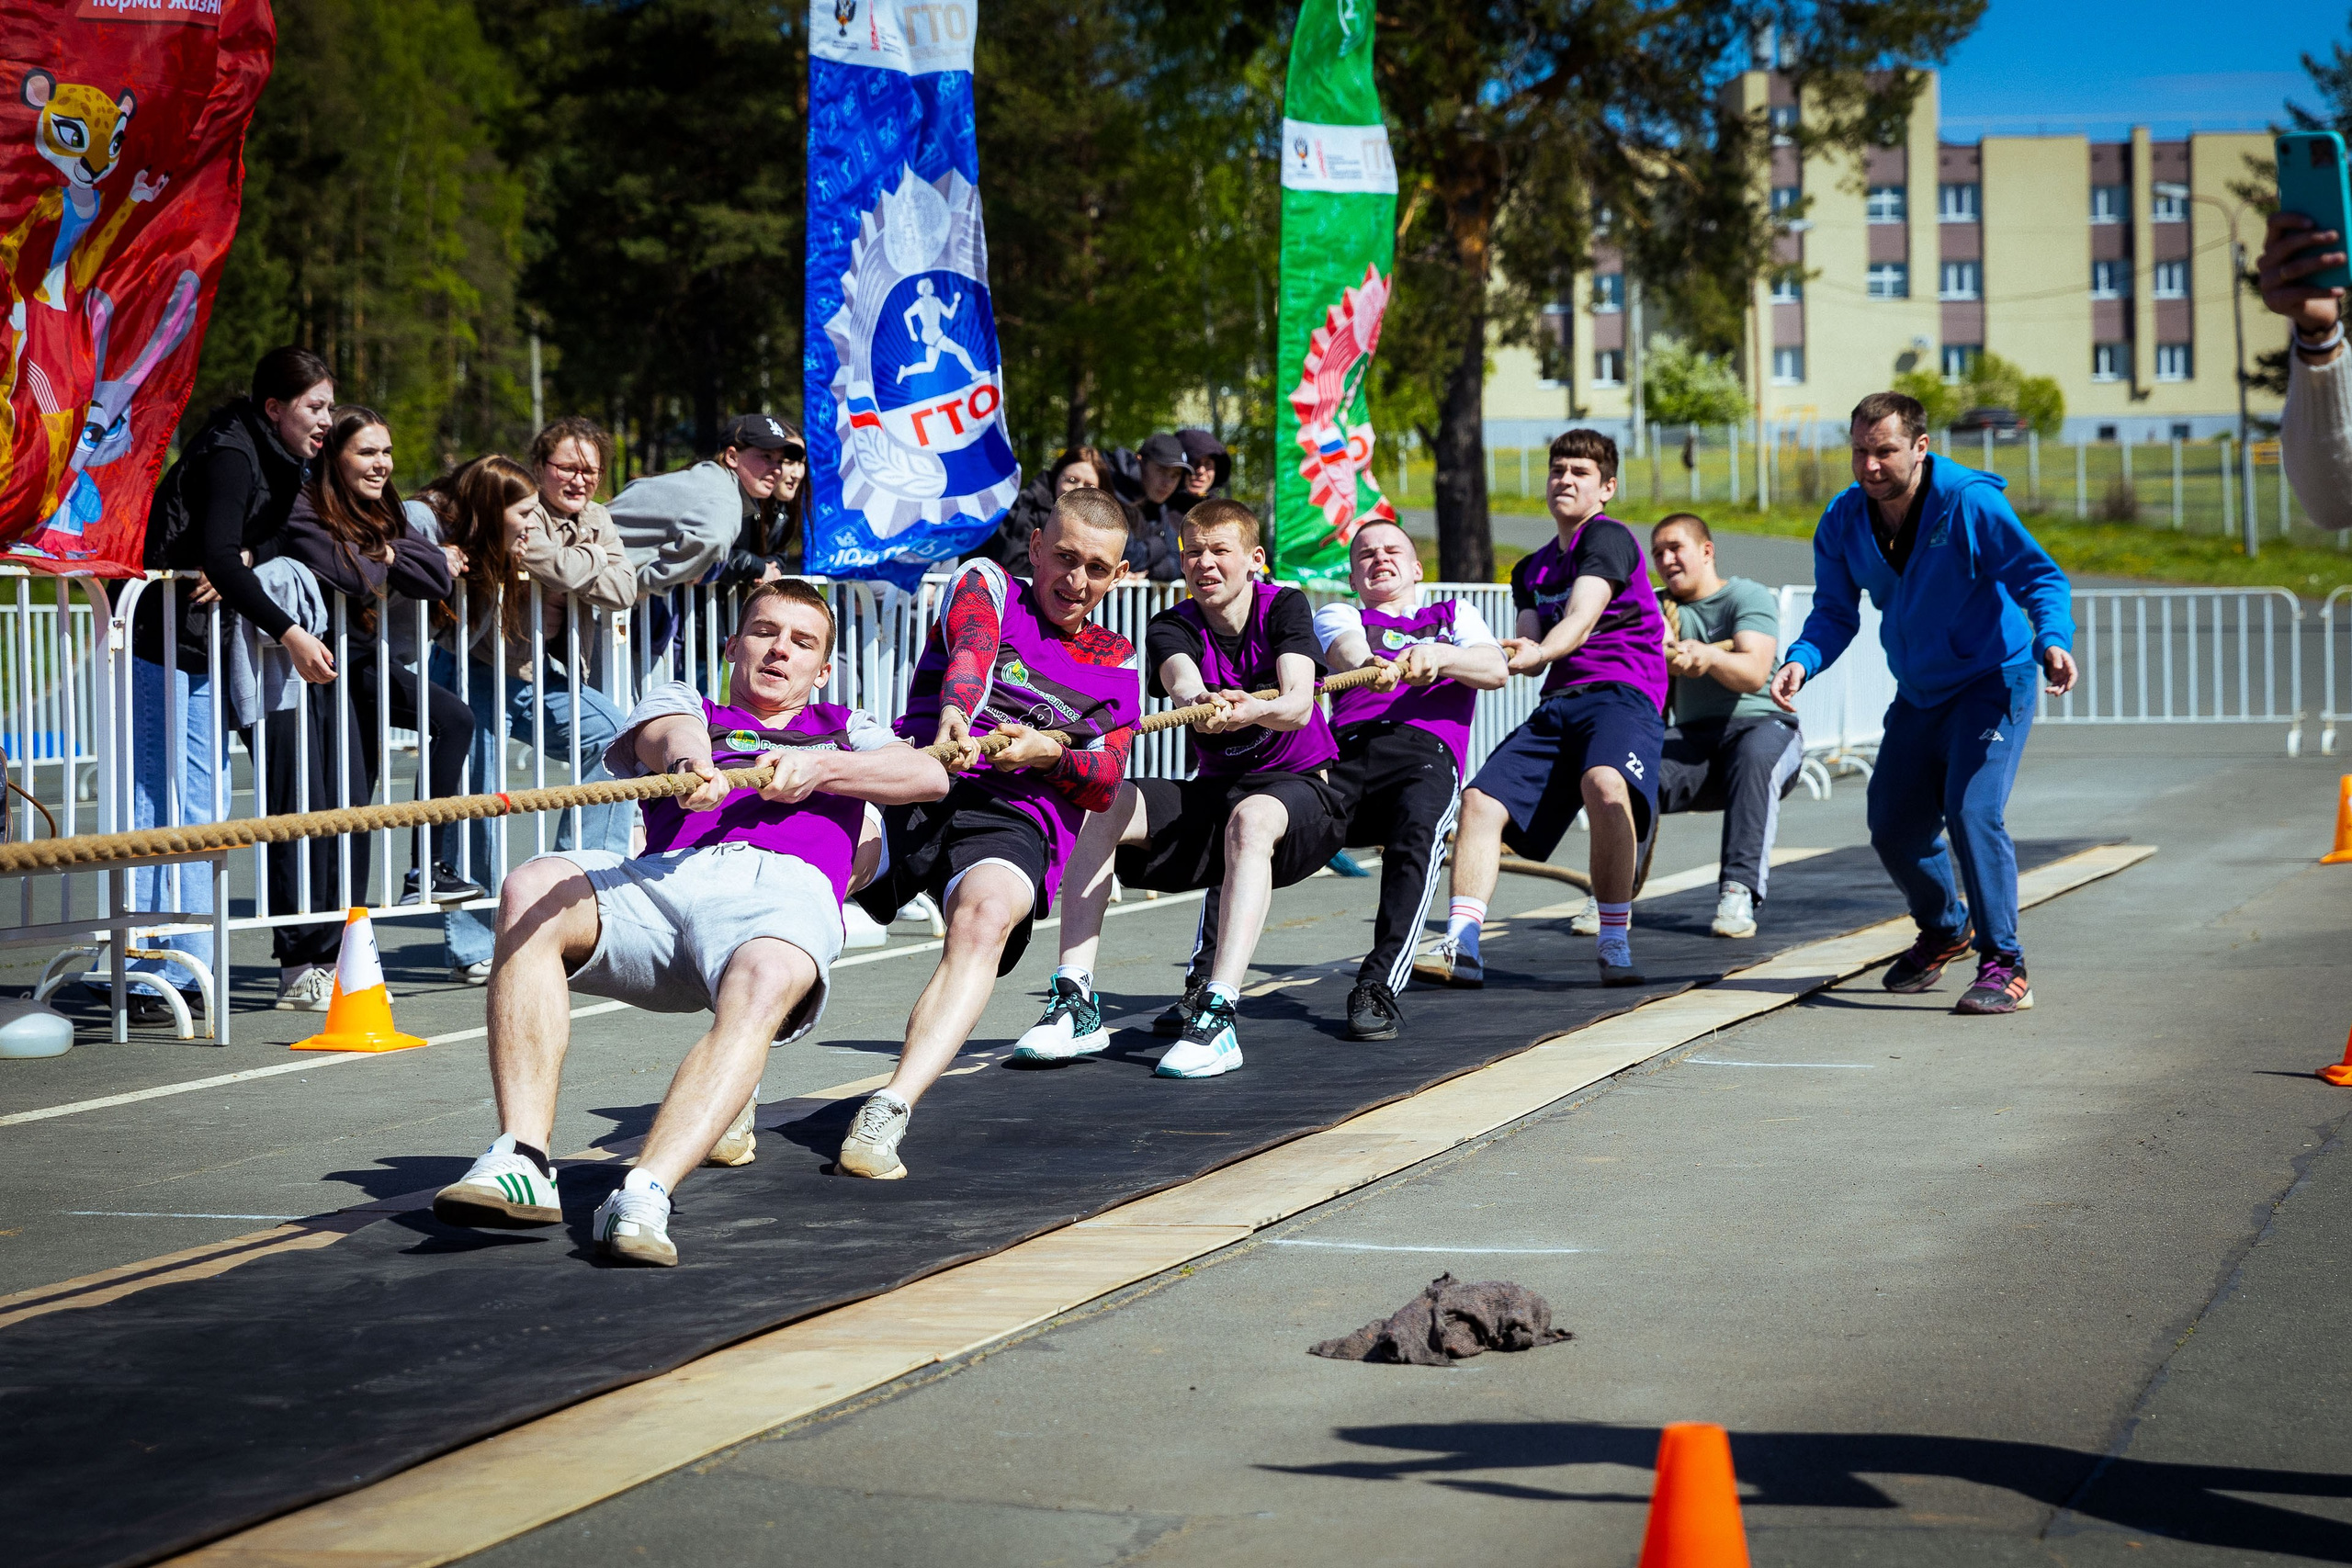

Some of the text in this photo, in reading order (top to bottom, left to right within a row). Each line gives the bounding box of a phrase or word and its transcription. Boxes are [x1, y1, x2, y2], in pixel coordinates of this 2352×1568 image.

[904, 4, 968, 45] ГТО
[910, 384, 1000, 446] ГТО
[1625, 751, 1645, 781] 22
